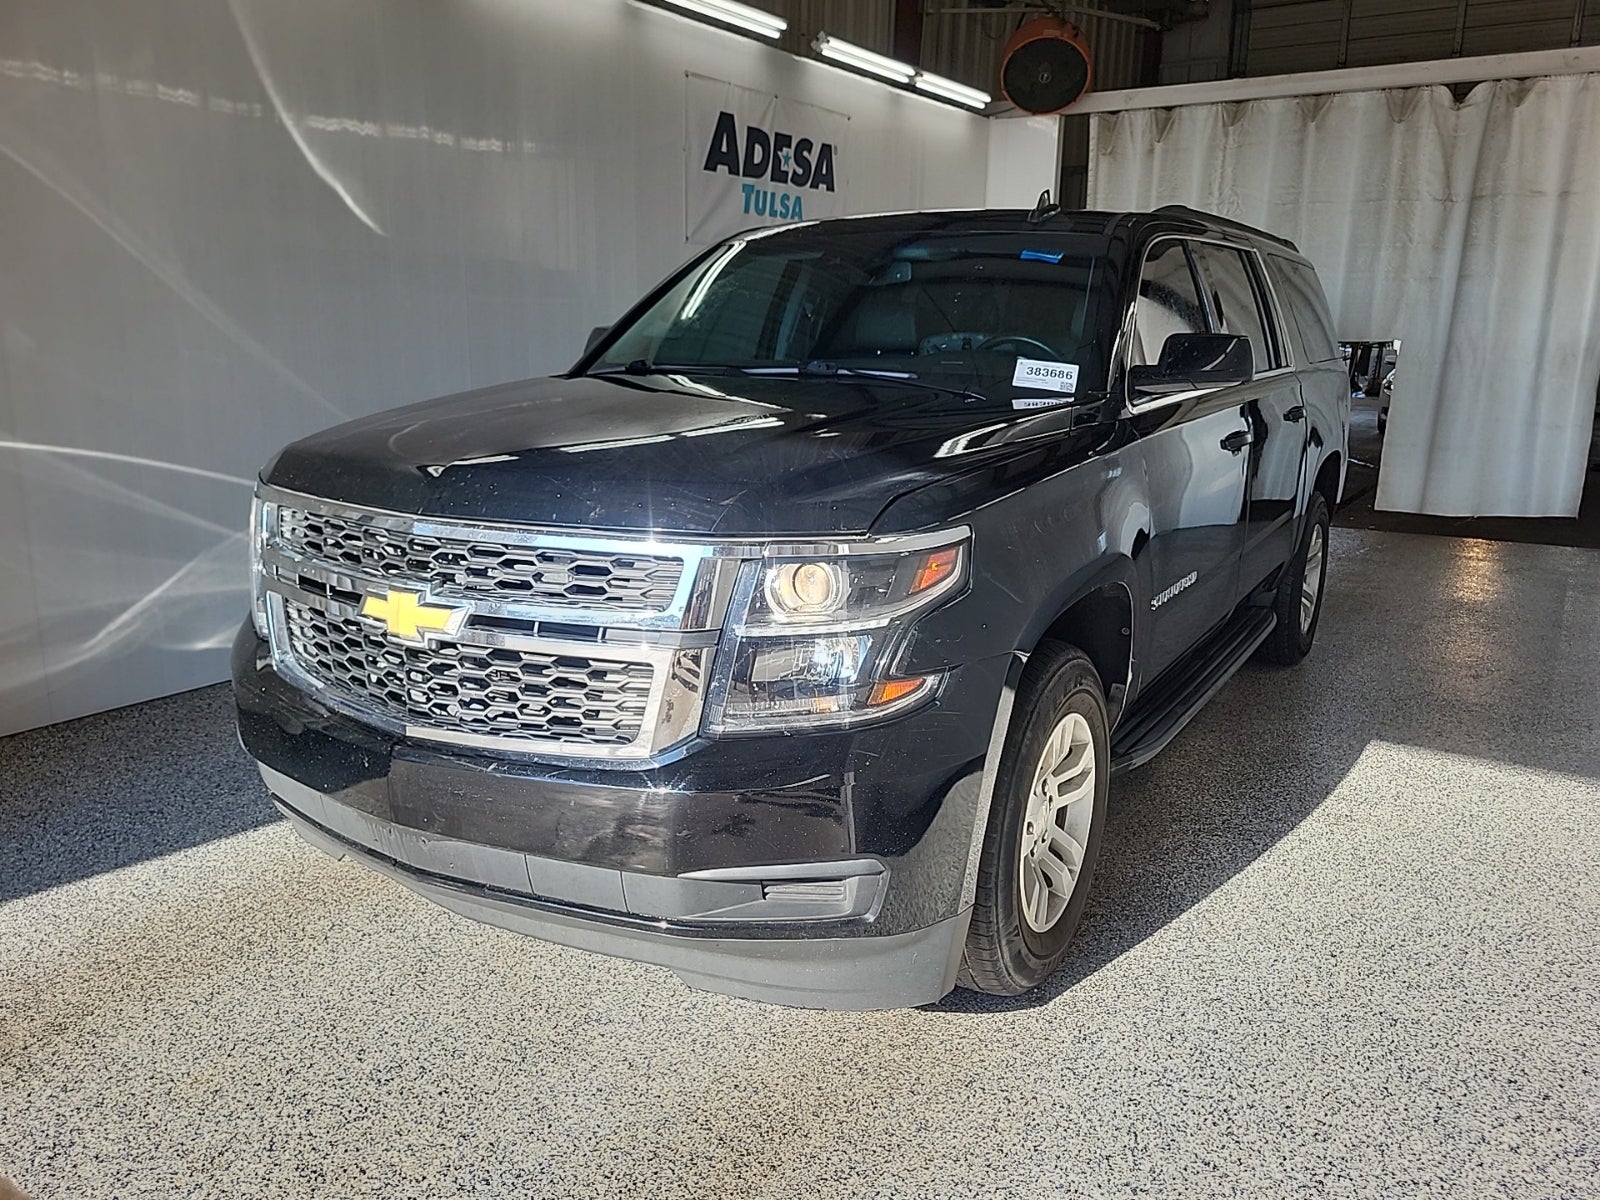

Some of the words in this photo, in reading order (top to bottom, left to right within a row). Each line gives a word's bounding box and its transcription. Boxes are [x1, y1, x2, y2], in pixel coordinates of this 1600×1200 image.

[703, 111, 834, 192] ADESA
[742, 184, 803, 221] TULSA
[1026, 366, 1073, 380] 383686
